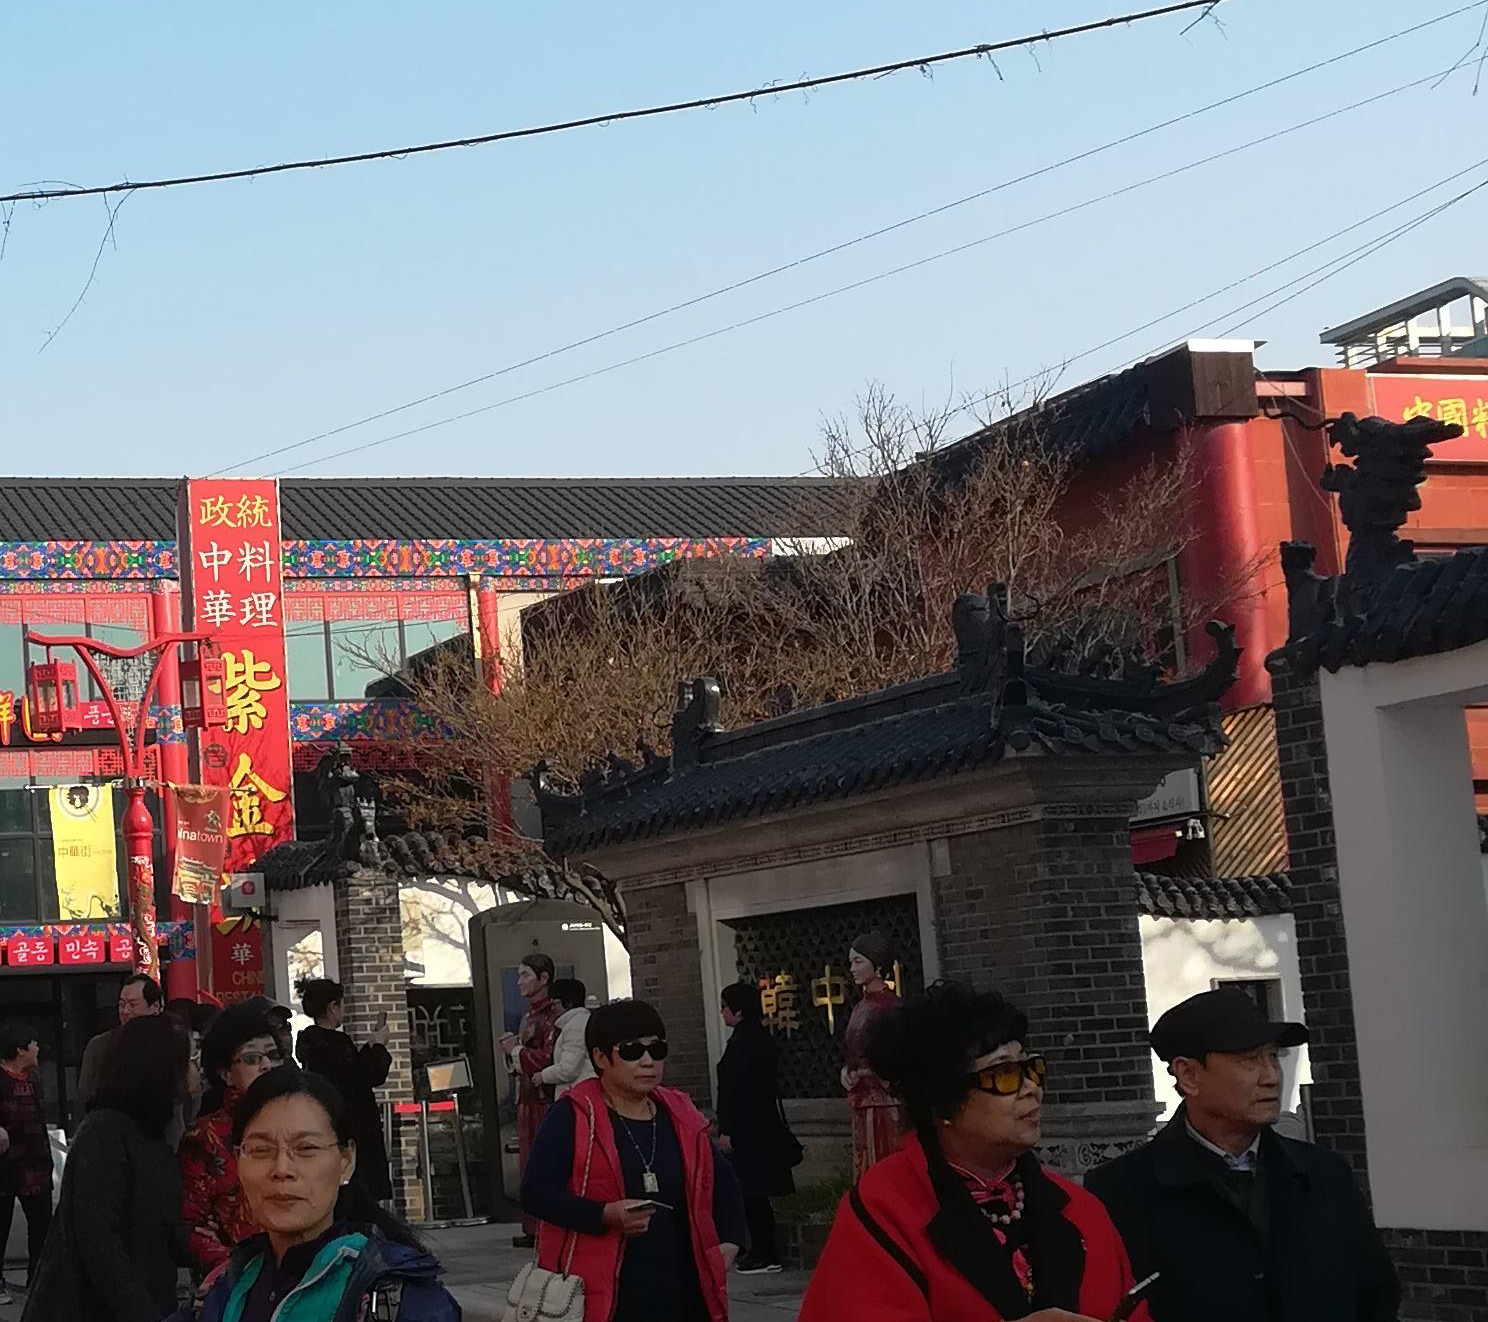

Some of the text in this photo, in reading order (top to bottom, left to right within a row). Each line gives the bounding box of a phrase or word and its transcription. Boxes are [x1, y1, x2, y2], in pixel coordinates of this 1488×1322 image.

[13, 941, 49, 963] 골동
[66, 939, 100, 960] 민속
[230, 942, 255, 966] 華
